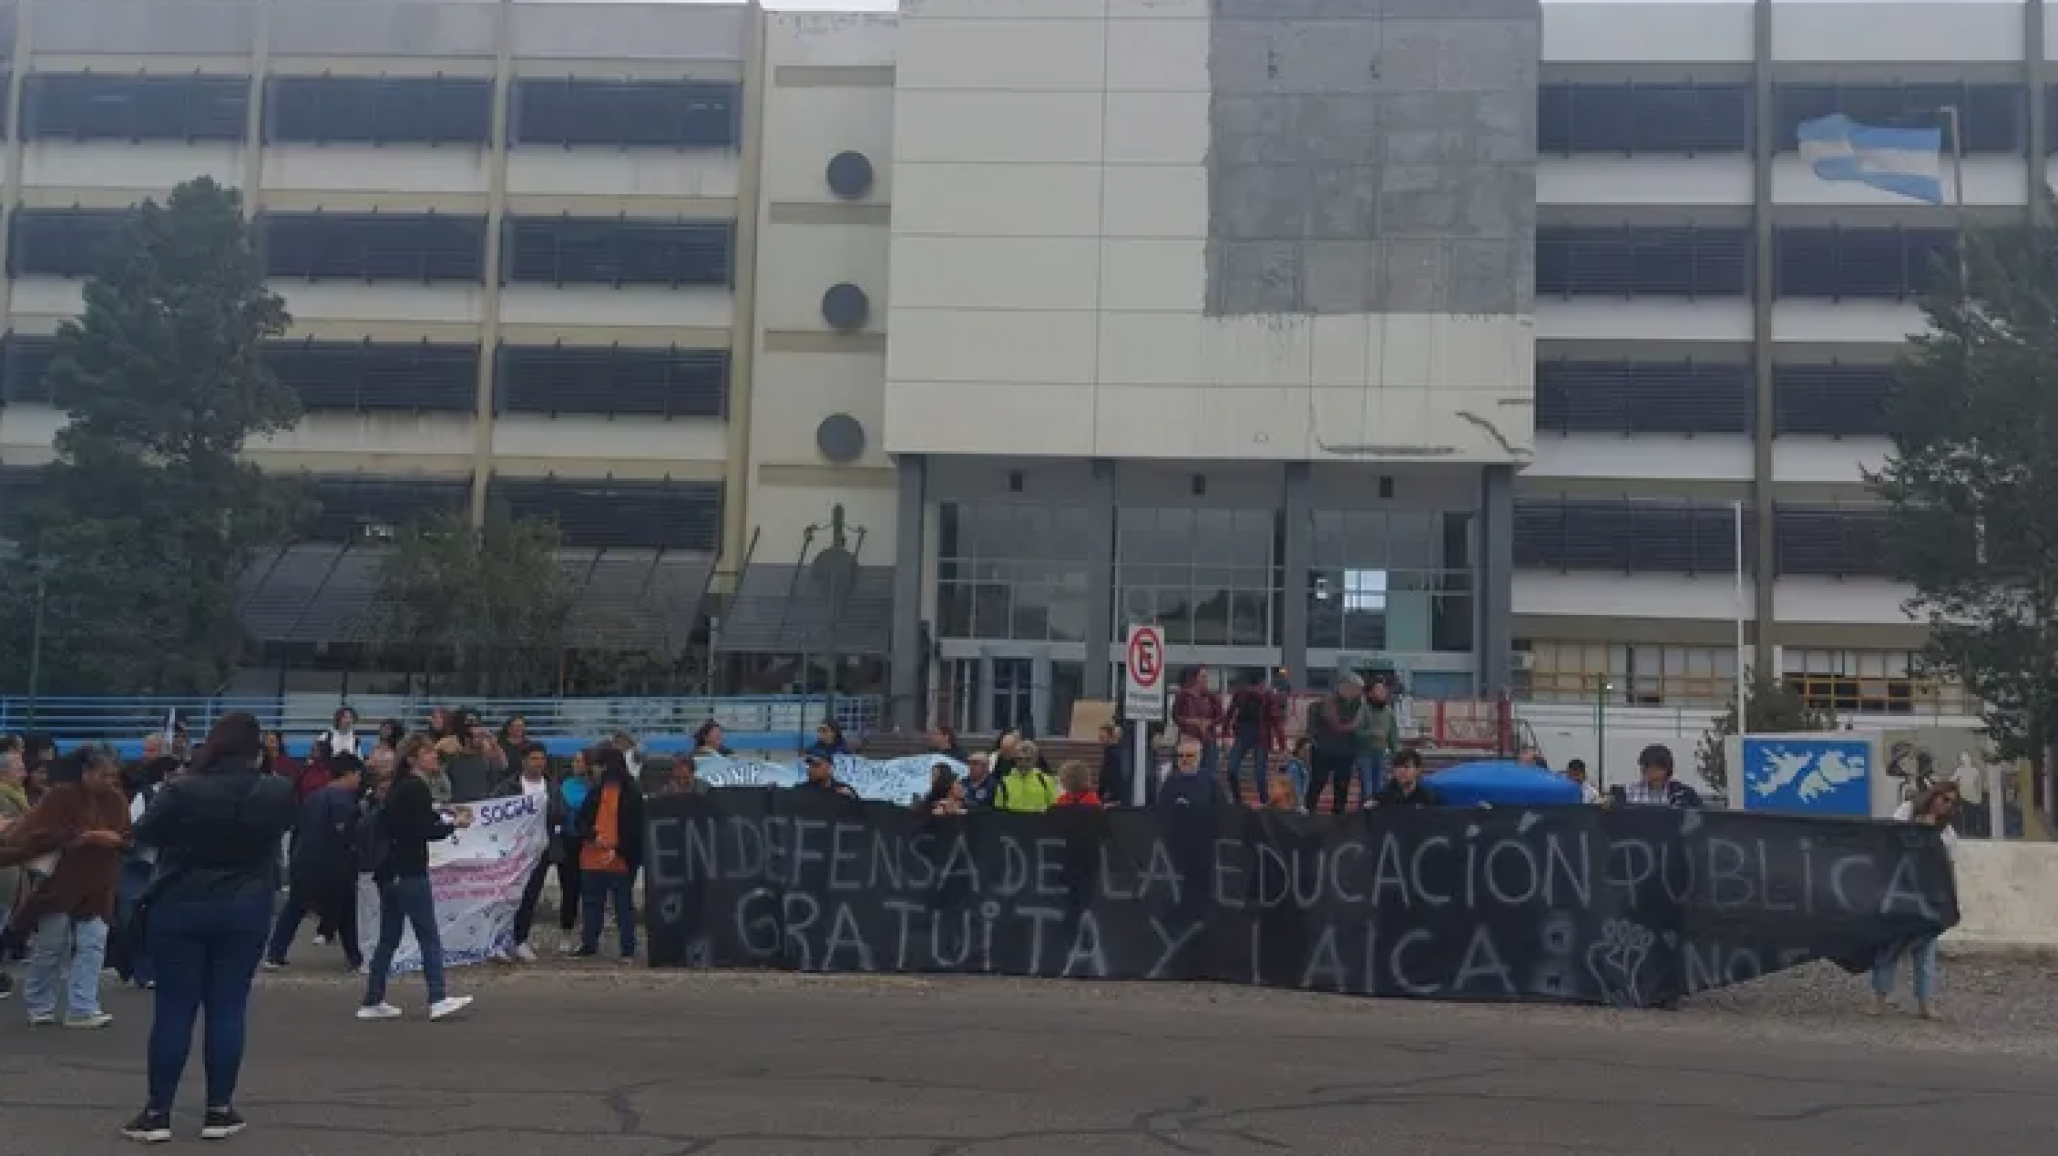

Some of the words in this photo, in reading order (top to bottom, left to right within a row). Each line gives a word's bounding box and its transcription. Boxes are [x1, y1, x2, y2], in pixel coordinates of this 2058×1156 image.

[650, 816, 716, 885] EN
[724, 813, 979, 893] DEFENSA
[993, 836, 1069, 896] DE
[1099, 838, 1184, 904] LA
[1145, 913, 1204, 979] Y
